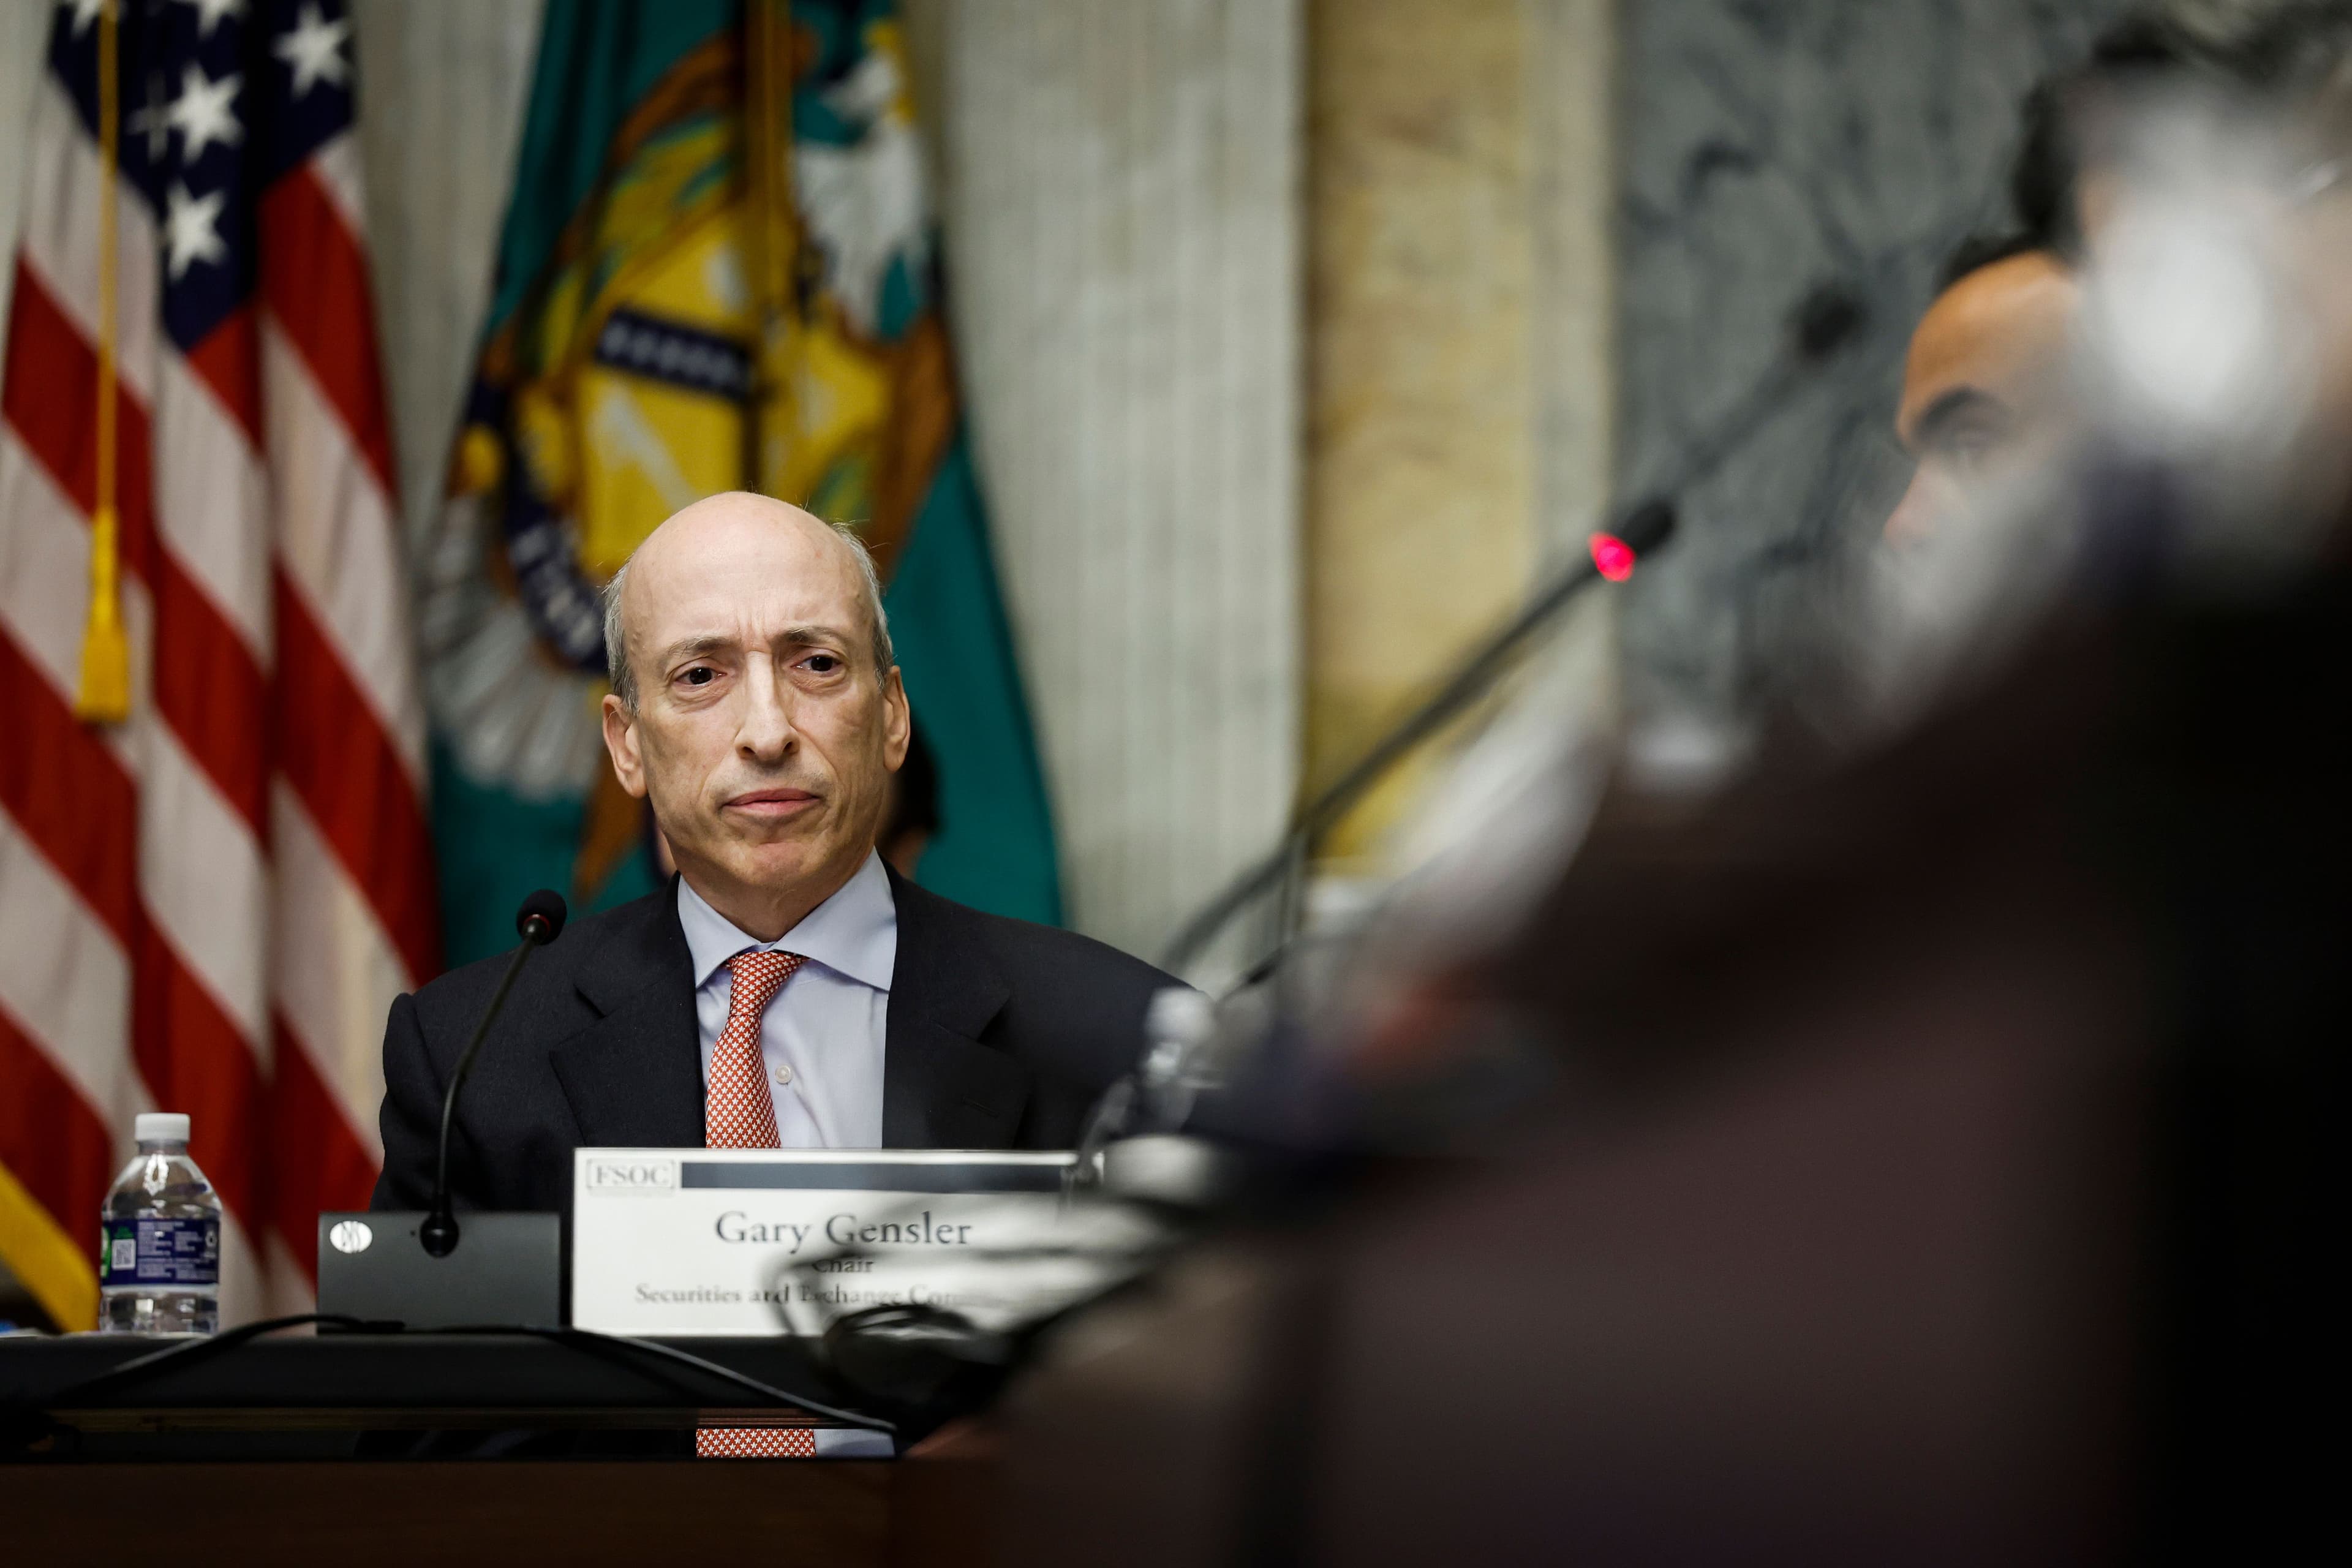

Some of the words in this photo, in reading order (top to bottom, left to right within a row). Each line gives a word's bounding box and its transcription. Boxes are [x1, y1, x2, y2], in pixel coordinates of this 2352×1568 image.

[597, 1164, 669, 1185] FSOC
[715, 1210, 812, 1254] Gary
[826, 1210, 973, 1246] Gensler
[812, 1256, 873, 1272] Chair
[635, 1282, 742, 1303] Securities
[748, 1283, 790, 1303] and
